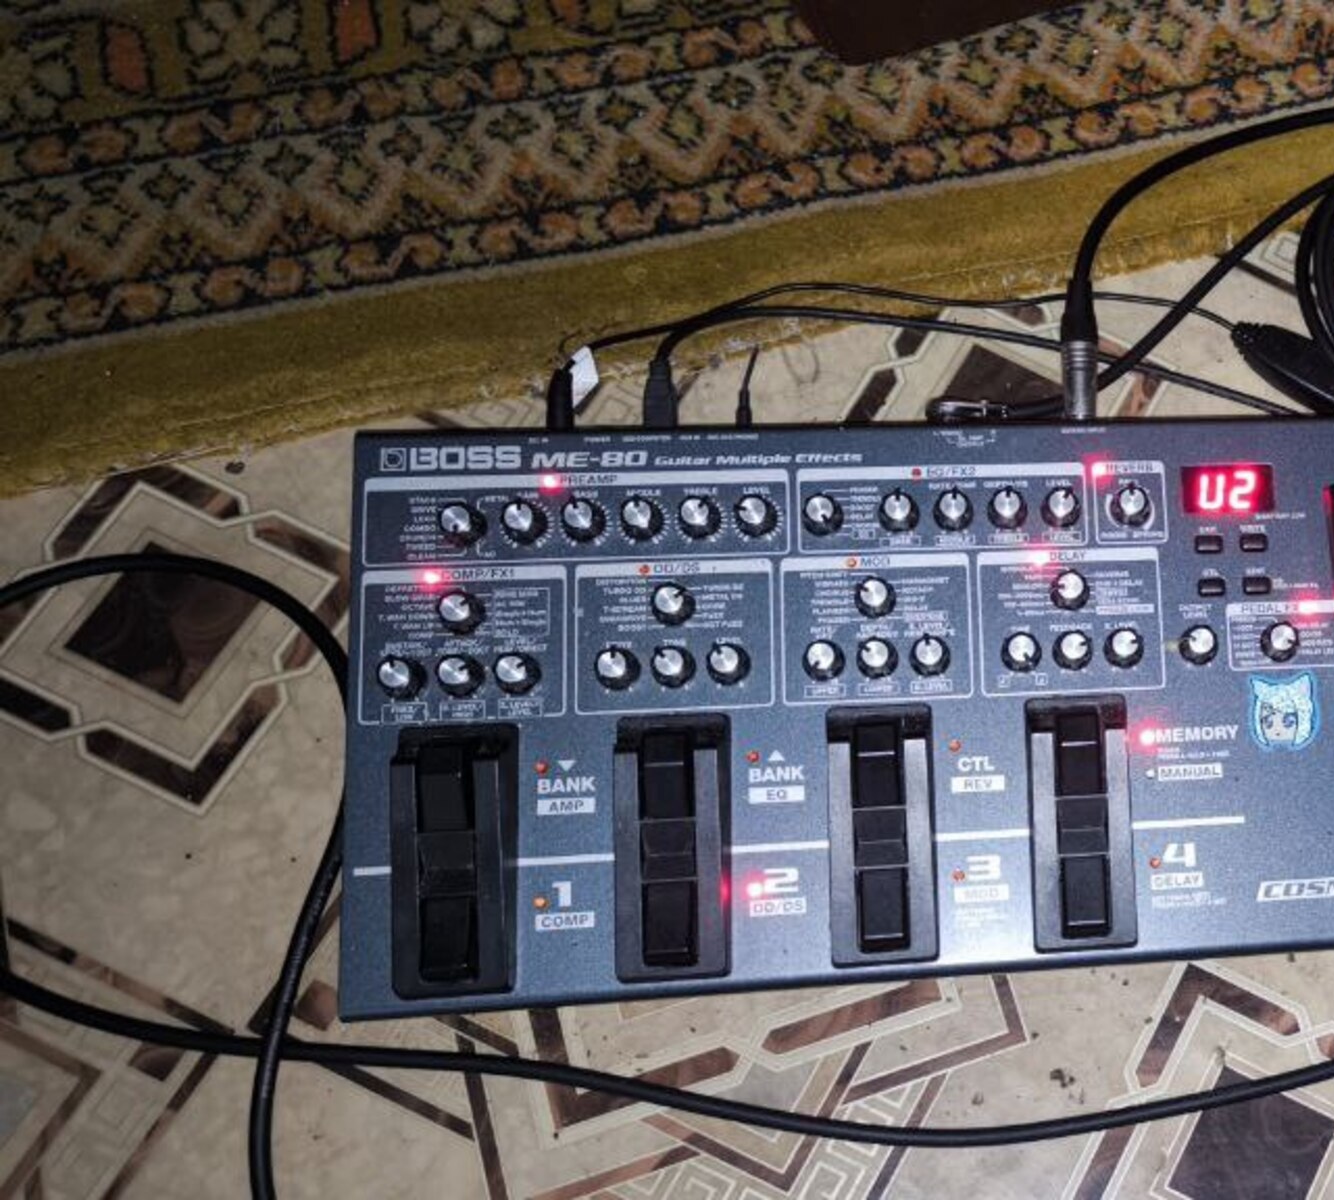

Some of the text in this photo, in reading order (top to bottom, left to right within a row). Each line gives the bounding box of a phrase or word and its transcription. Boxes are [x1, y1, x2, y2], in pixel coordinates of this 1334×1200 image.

[410, 445, 522, 470] BOSS
[530, 450, 863, 468] ME-80 Guitar Multiple Effects
[560, 474, 617, 485] PREAMP
[1197, 470, 1257, 510] U2
[1049, 551, 1086, 561] DELAY
[1155, 725, 1239, 743] MEMORY
[957, 755, 996, 772] CTL
[1160, 764, 1221, 779] MANUAL
[748, 764, 805, 783] BANK
[536, 776, 596, 795] BANK
[963, 777, 993, 790] REV
[766, 788, 788, 801] EQ
[549, 800, 585, 813] AMP
[1162, 842, 1197, 867] 4
[966, 854, 1001, 880] 3
[762, 867, 800, 894] 2
[1153, 873, 1201, 887] DELAY
[551, 880, 572, 908] 1
[753, 900, 804, 914] OD/DS
[540, 915, 590, 929] COMP
